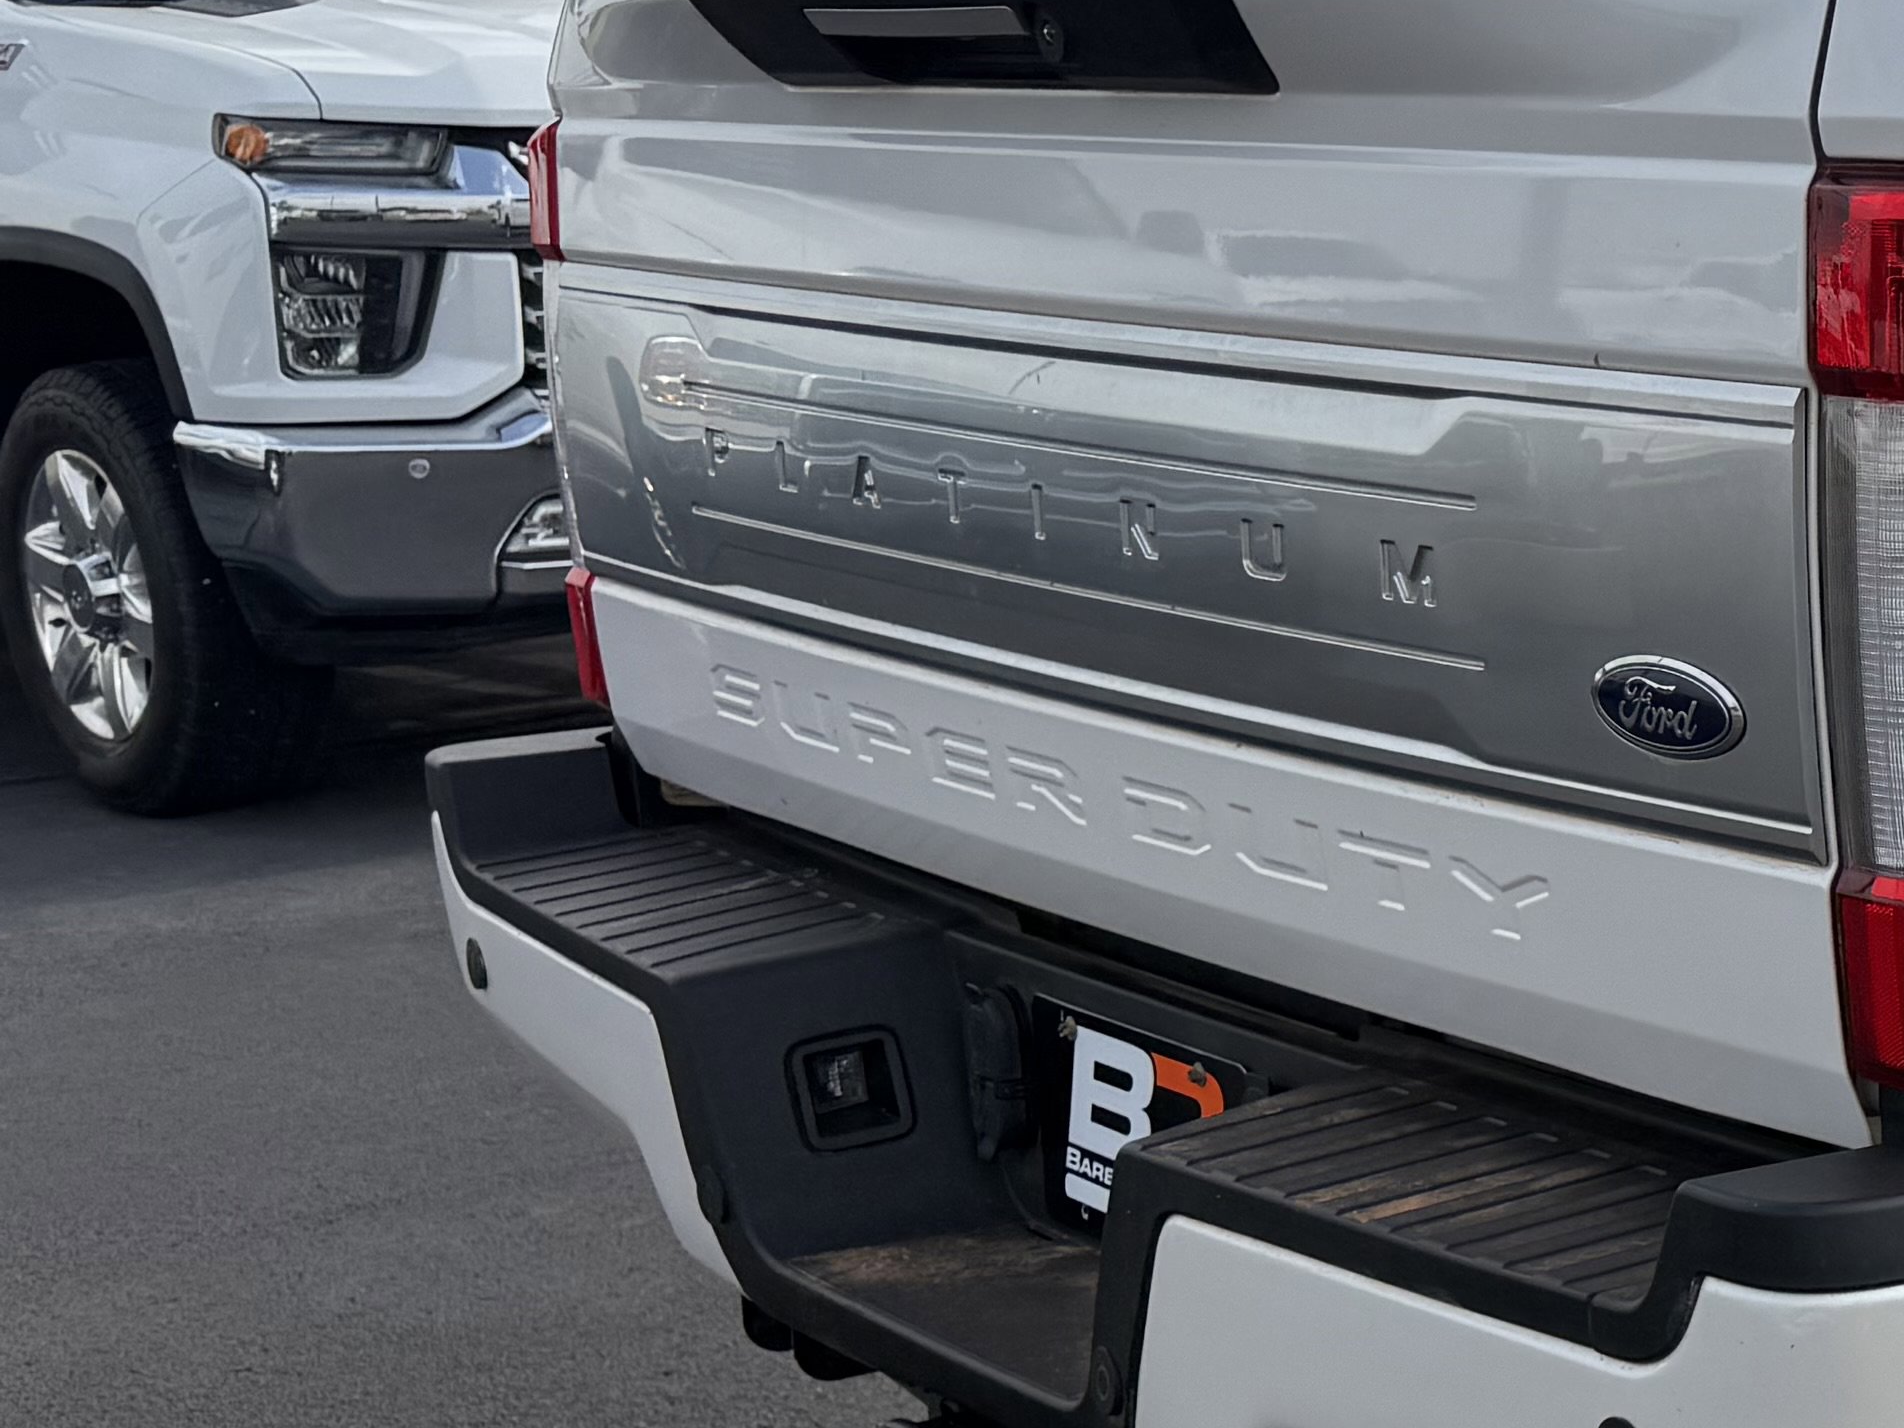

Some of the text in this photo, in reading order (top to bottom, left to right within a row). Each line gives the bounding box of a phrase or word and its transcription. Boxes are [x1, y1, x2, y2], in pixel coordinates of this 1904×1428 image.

[703, 426, 1438, 609] PLATINUM
[1618, 675, 1699, 742] Ford
[709, 663, 1550, 941] SUPER DUTY
